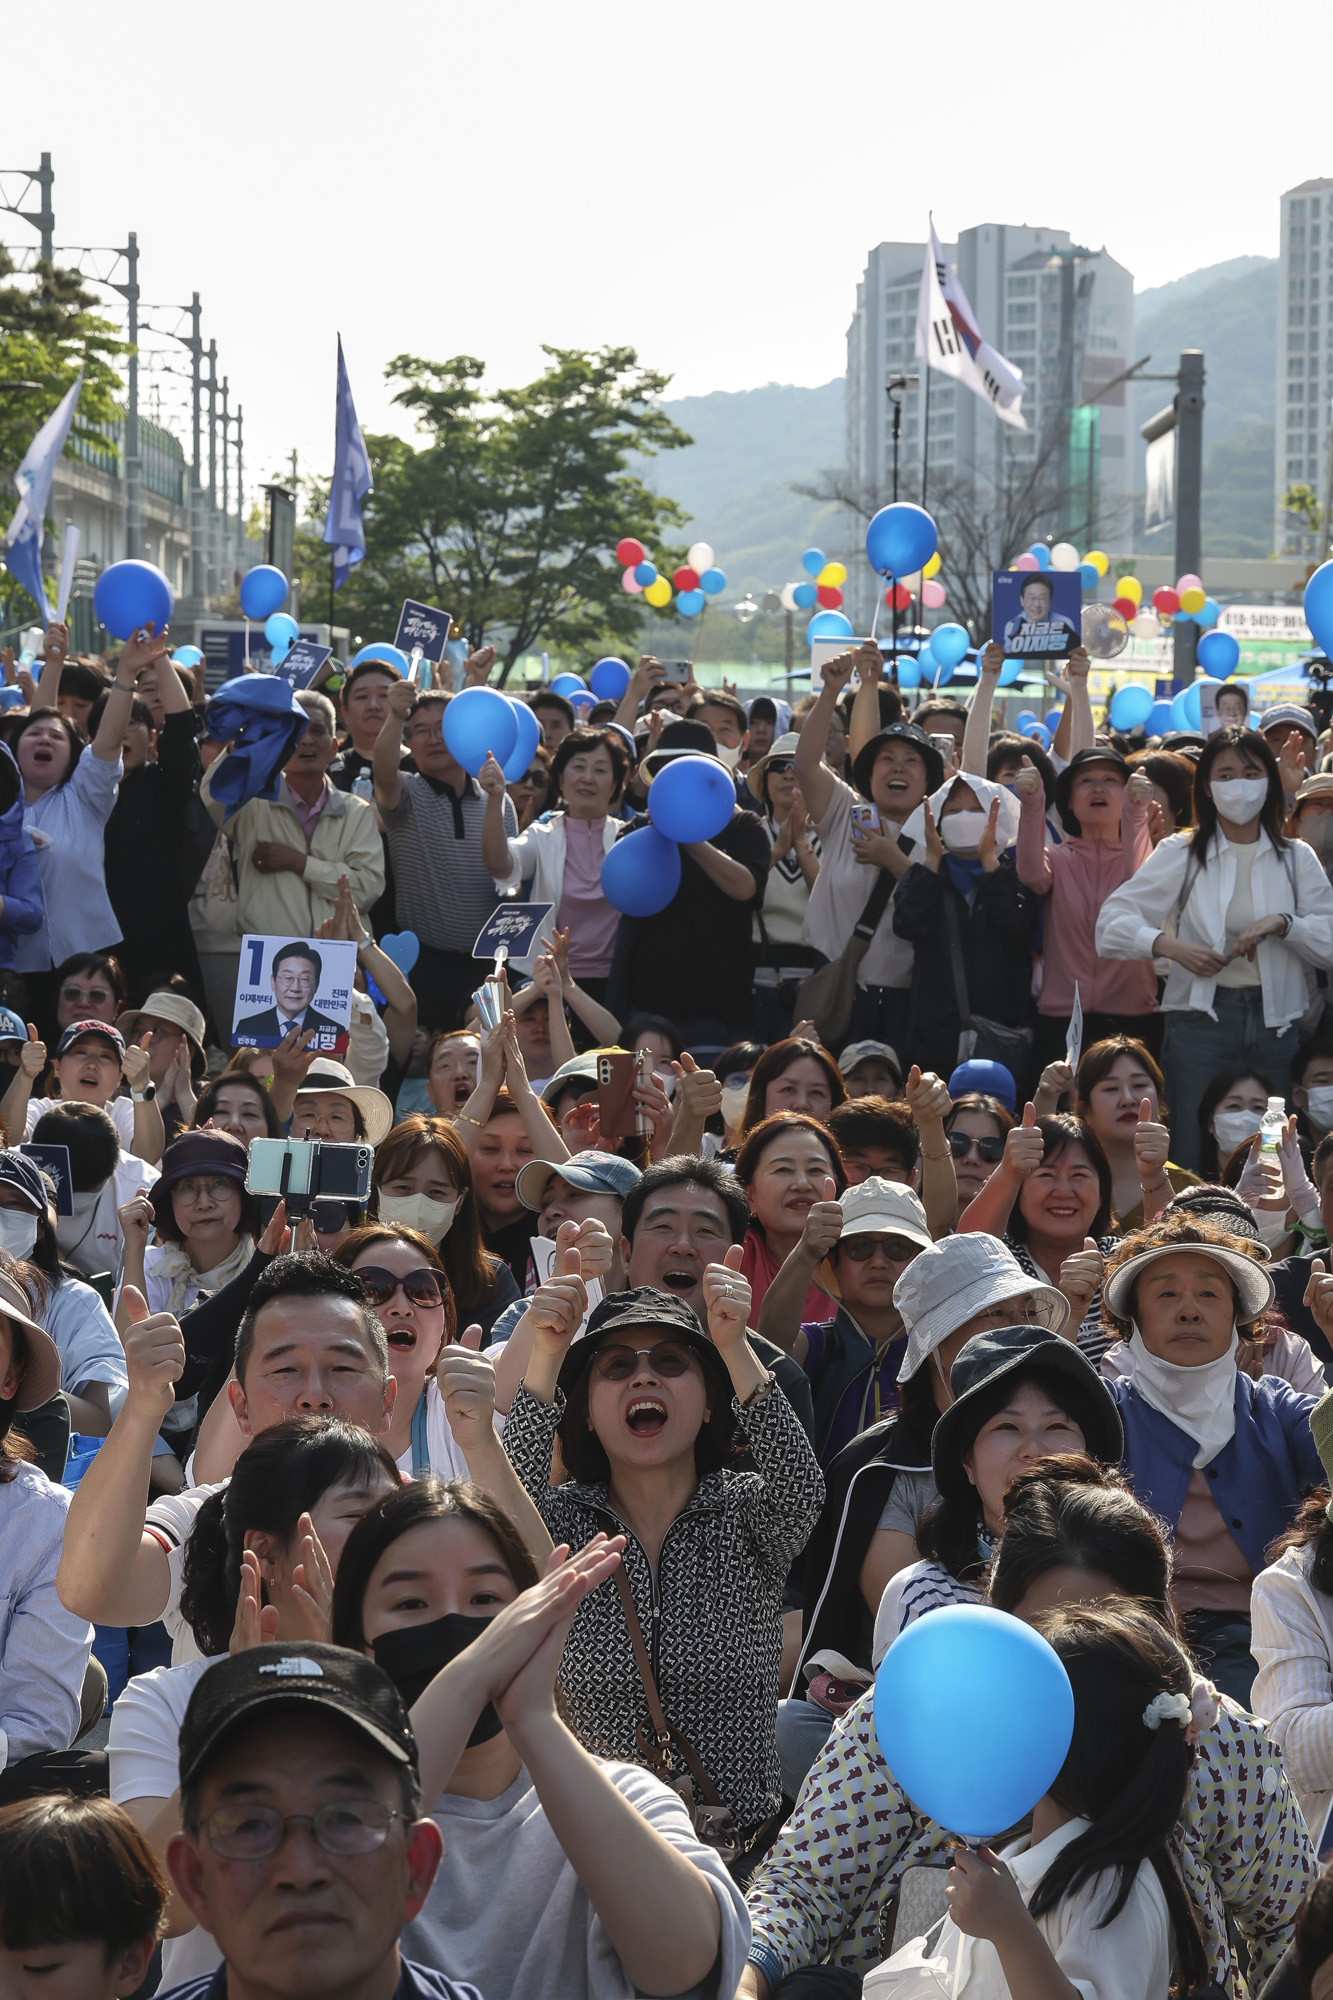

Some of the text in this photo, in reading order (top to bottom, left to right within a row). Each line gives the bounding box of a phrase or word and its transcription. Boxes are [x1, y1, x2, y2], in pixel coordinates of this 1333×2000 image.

[1020, 621, 1065, 636] 지금은
[1010, 633, 1069, 653] 이재명
[247, 940, 264, 986] 1
[239, 993, 273, 1005] 이제부터
[331, 989, 349, 1000] 진짜
[314, 999, 348, 1011] 대한민국
[318, 1024, 338, 1033] 지금은
[237, 1036, 257, 1046] 민주당
[303, 1032, 337, 1051] 재명
